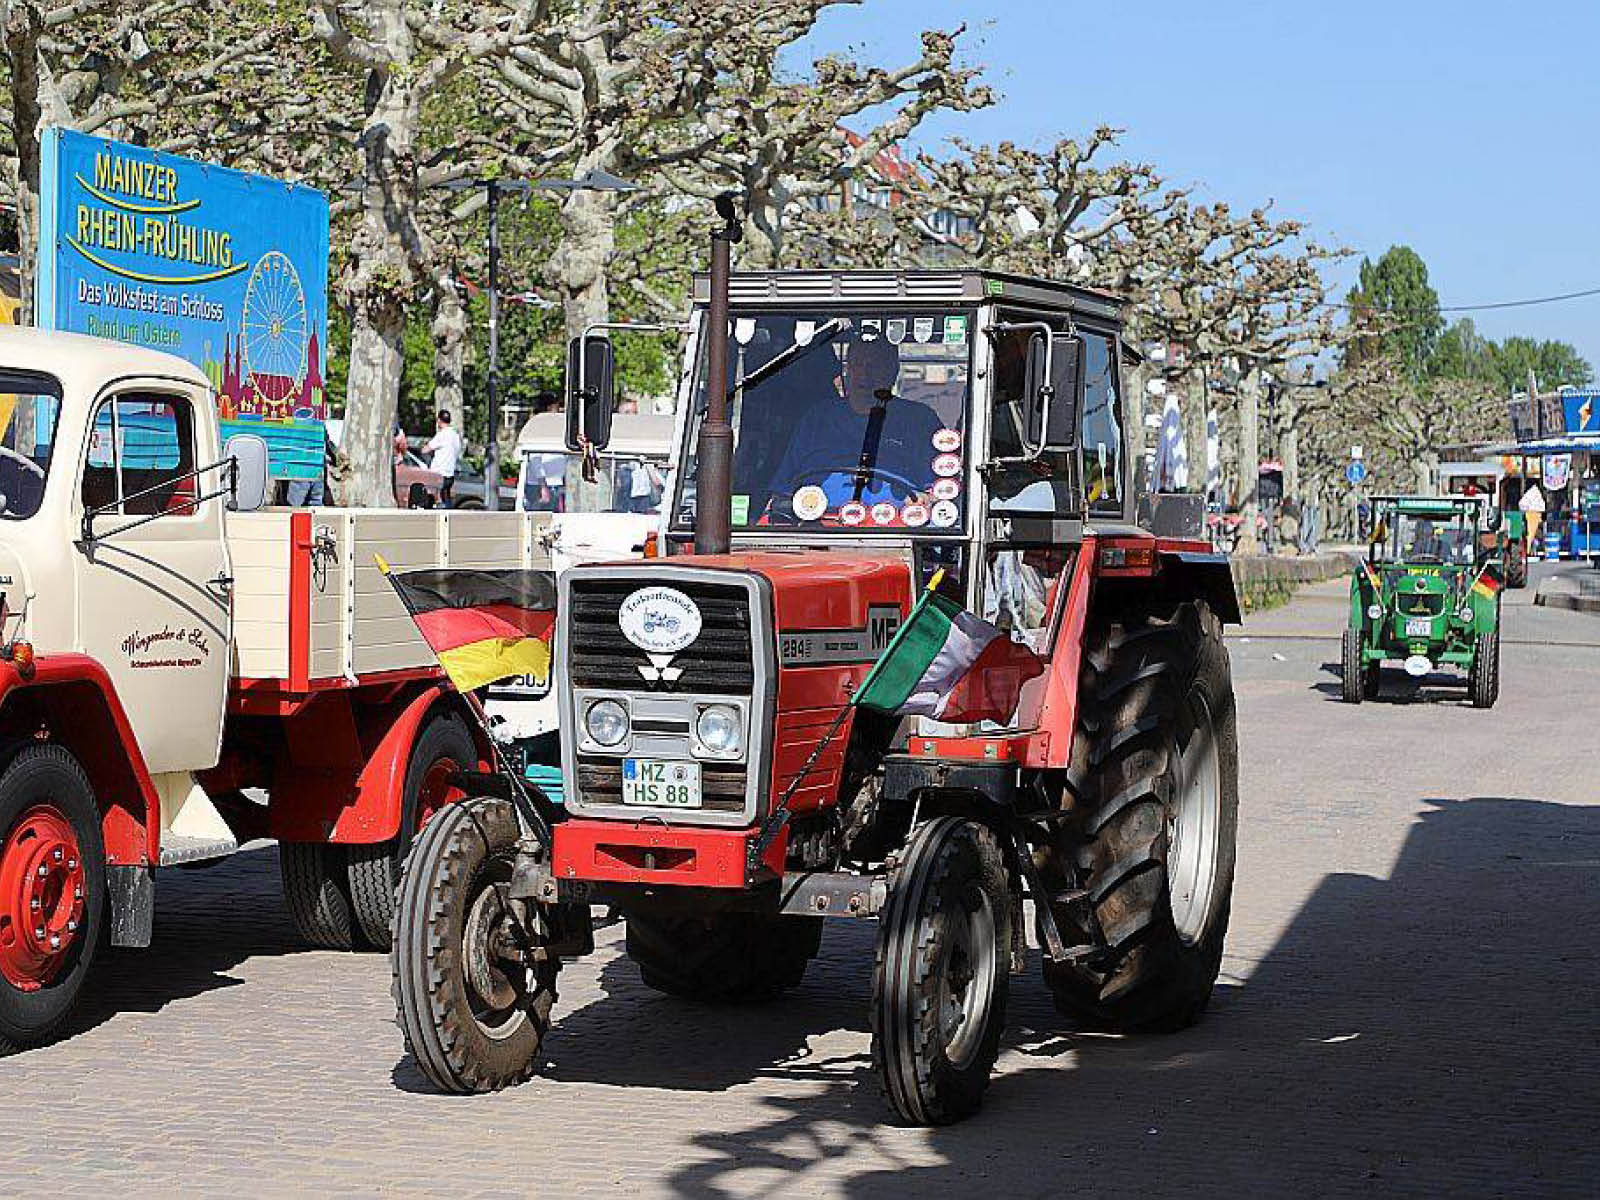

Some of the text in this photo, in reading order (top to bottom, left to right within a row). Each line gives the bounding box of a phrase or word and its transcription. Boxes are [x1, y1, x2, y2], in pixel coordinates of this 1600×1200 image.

[94, 152, 178, 203] MAINZER
[77, 204, 233, 268] RHEIN-FRÜHLING
[78, 278, 225, 321] Das Volksfest am Schloss
[121, 321, 139, 342] um
[142, 321, 181, 347] Ostern
[641, 763, 665, 782] MZ
[634, 783, 688, 803] HS 88
